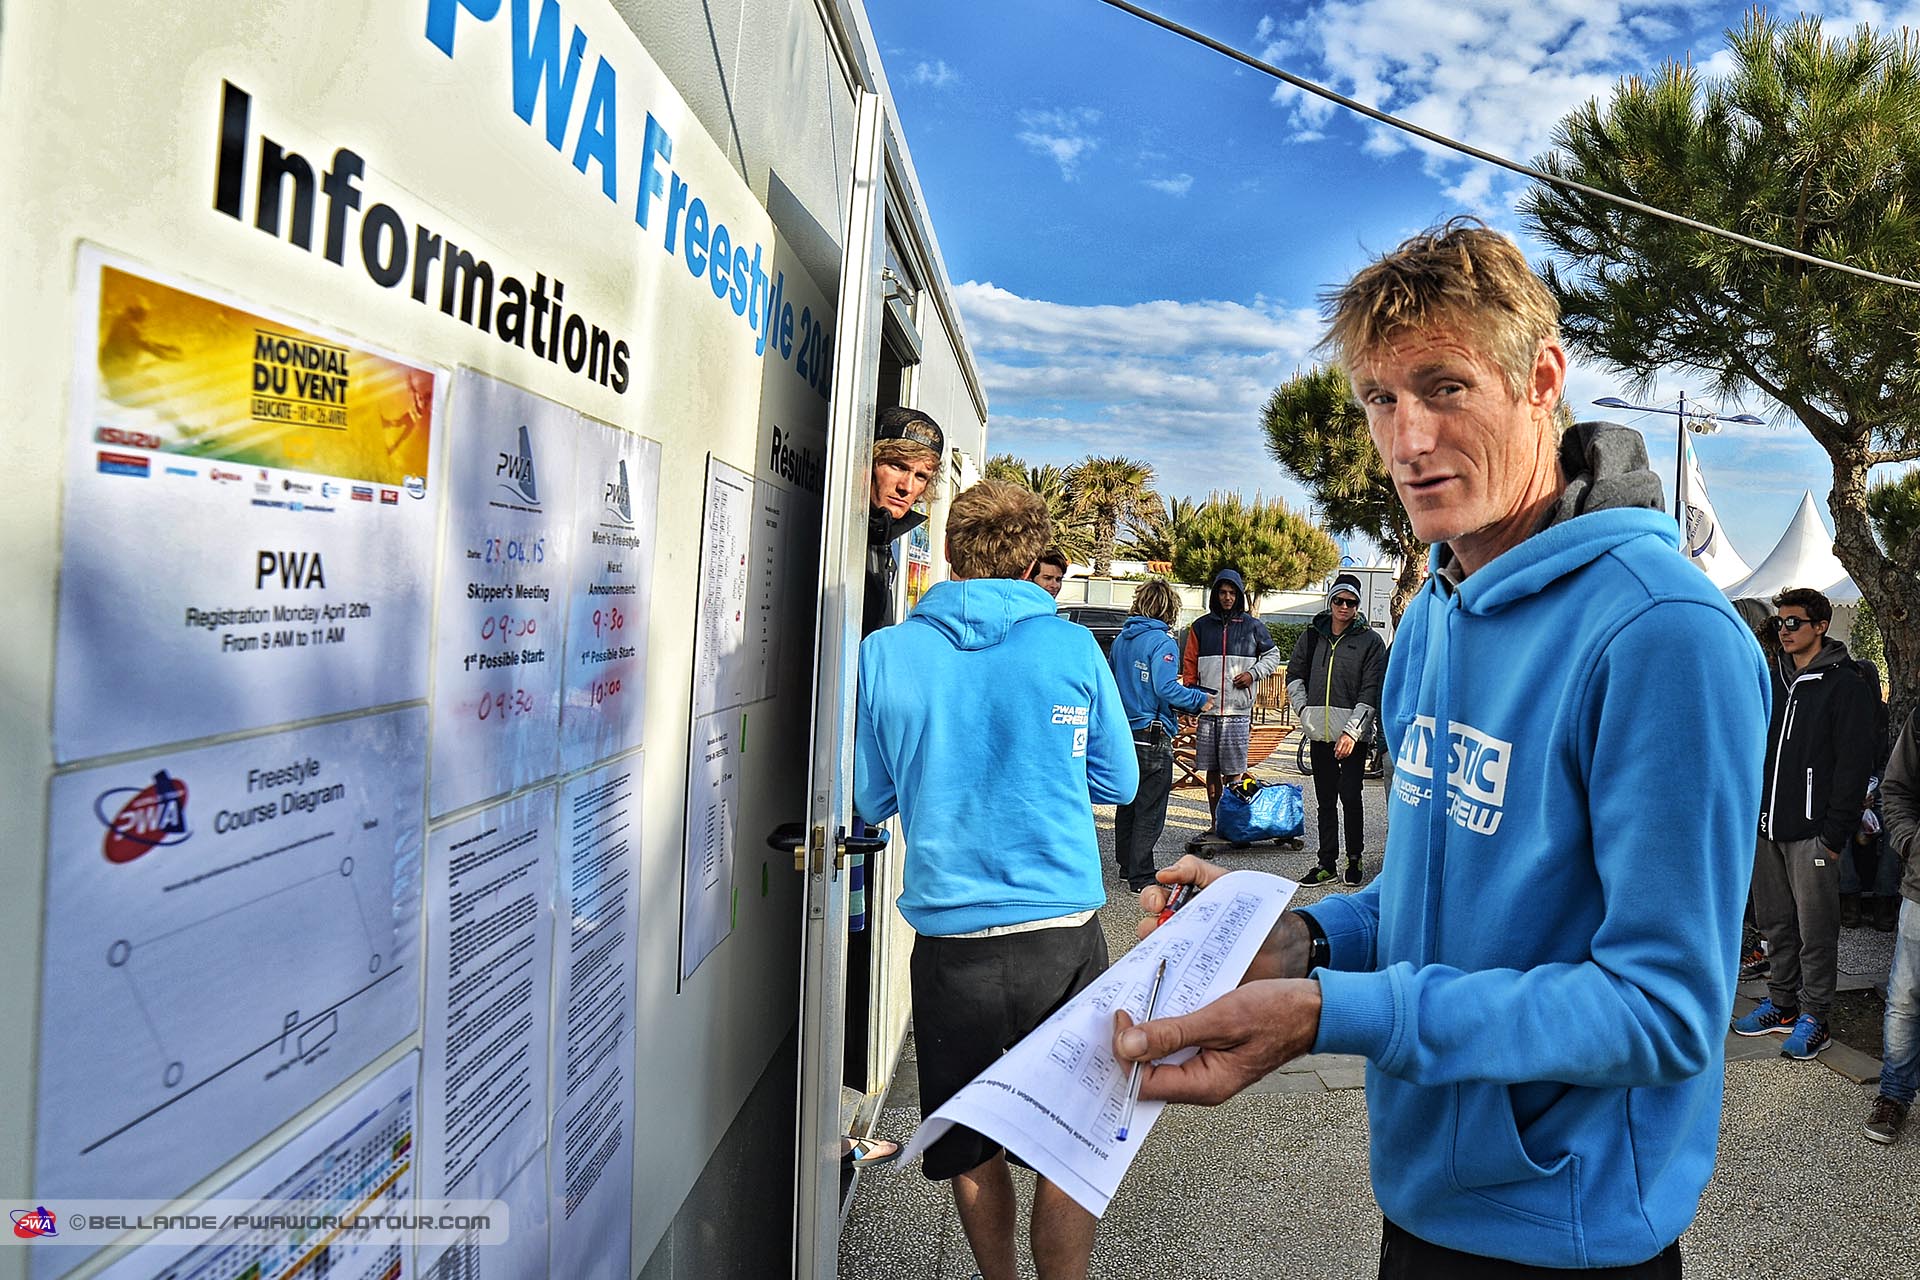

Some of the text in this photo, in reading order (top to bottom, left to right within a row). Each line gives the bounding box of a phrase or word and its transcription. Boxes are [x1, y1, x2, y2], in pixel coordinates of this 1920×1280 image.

[212, 78, 630, 394] Informations
[635, 111, 794, 360] Freestyle
[254, 335, 349, 377] MONDIAL
[253, 362, 348, 404] DU VENT
[252, 399, 292, 419] LEUCATE
[97, 426, 161, 450] ISUZU
[496, 453, 532, 483] PWA
[605, 483, 629, 506] PWA
[592, 531, 641, 551] Men's Freestyle
[255, 551, 326, 590] PWA
[607, 560, 622, 574] Next
[467, 583, 550, 602] Skipper's Meeting
[185, 602, 371, 631] Registration Monday April 20th
[592, 607, 624, 638] 9:30
[222, 627, 346, 653] From 9 AM to 11 AM
[464, 649, 545, 671] 1st Possible Start:
[581, 645, 636, 665] 1st Possible Start:
[478, 689, 533, 721] 09:30
[590, 679, 621, 708] 10:00
[1052, 704, 1075, 716] PWA
[247, 757, 320, 793] Freestyle
[214, 783, 345, 835] Course Diagram
[1398, 789, 1420, 807] TOUR
[113, 799, 179, 840] PWA
[1017, 1090, 1051, 1116] elimination
[1050, 1112, 1073, 1135] freestyle
[1073, 1131, 1095, 1151] Leucate
